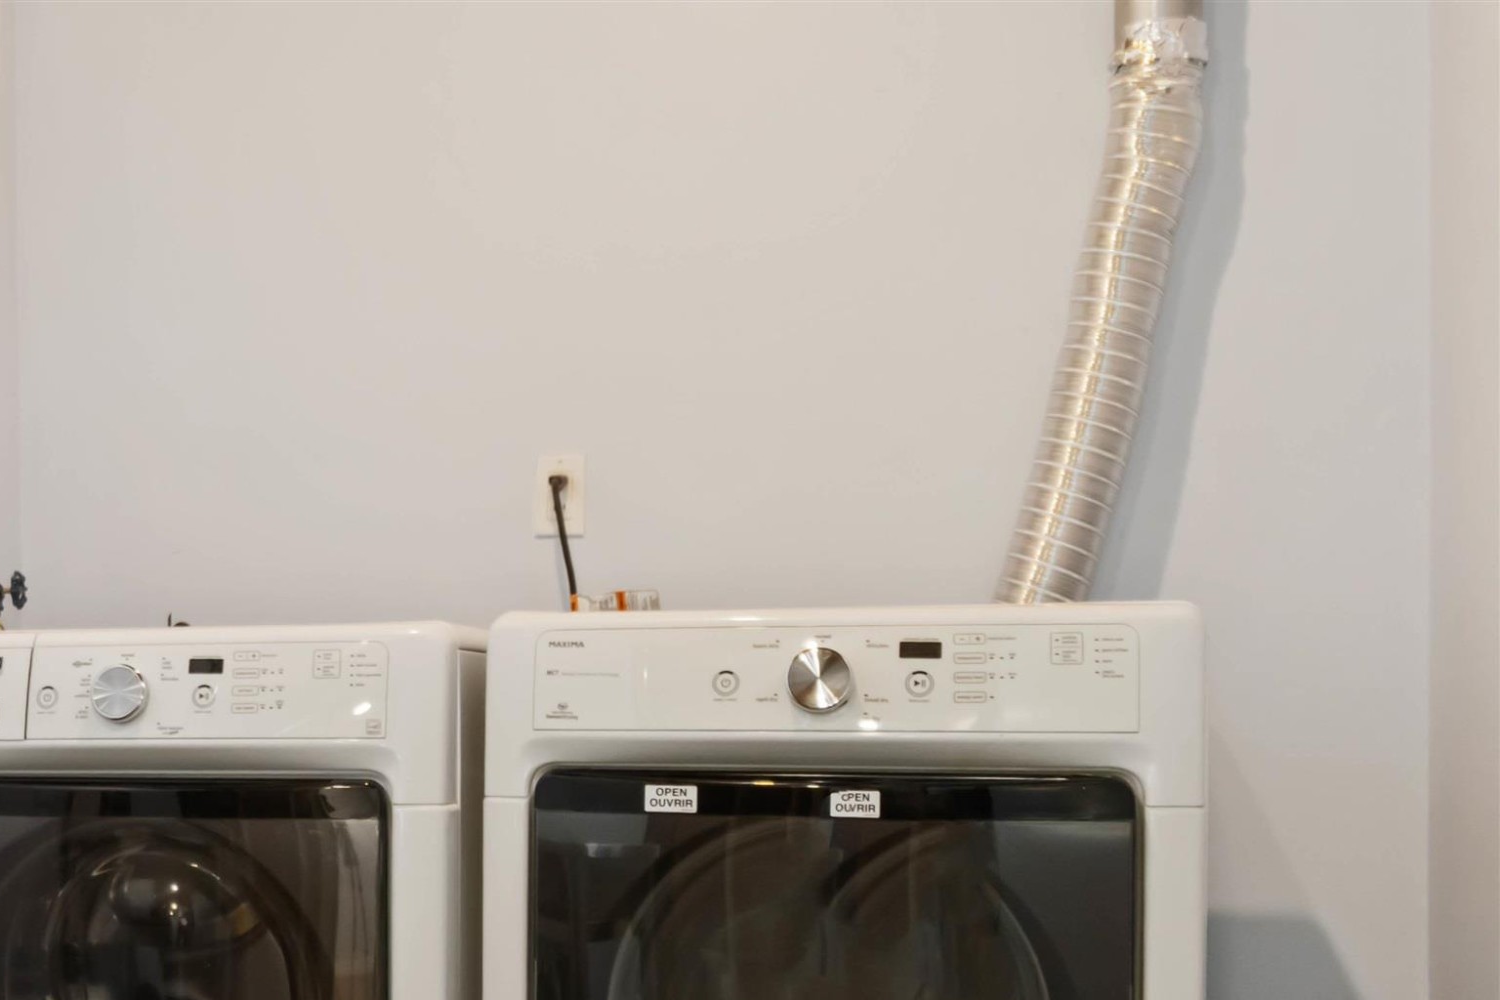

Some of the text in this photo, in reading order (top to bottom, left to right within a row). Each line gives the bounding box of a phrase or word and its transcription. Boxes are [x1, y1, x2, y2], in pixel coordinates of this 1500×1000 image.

[655, 787, 688, 797] OPEN
[841, 793, 870, 802] OPEN
[649, 798, 693, 808] OUVRIR
[835, 803, 876, 813] OUVRIR
